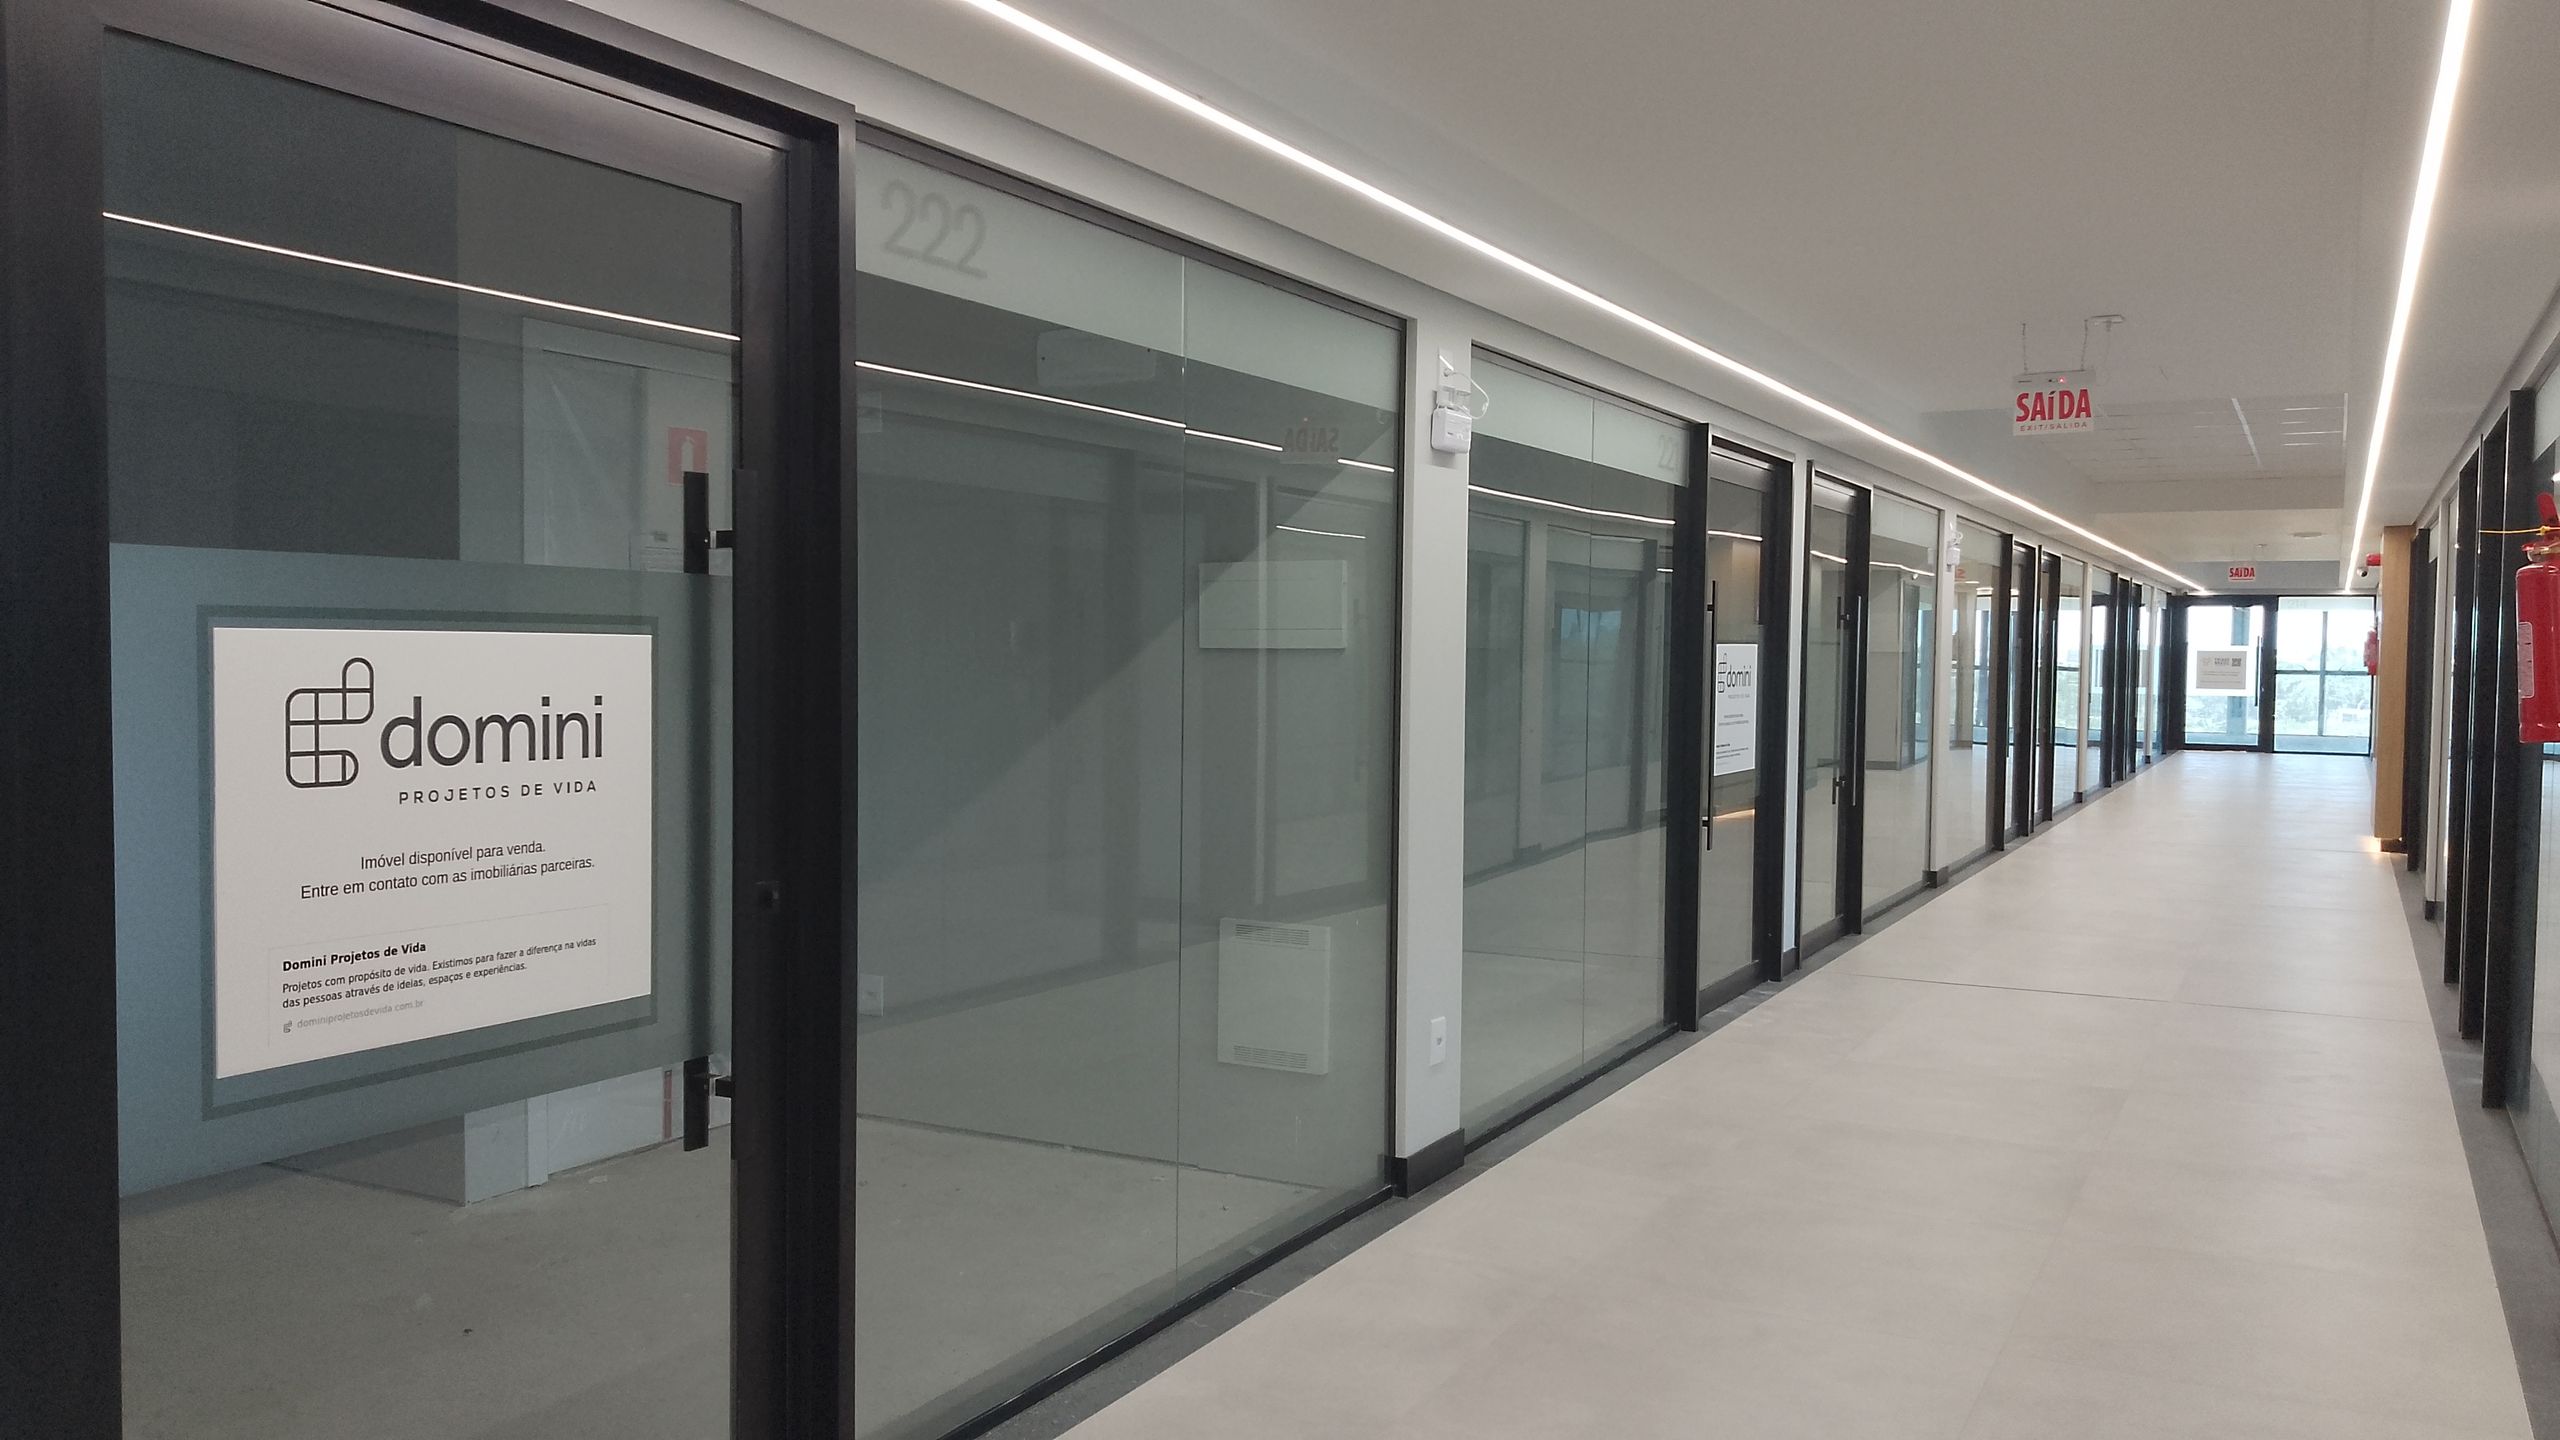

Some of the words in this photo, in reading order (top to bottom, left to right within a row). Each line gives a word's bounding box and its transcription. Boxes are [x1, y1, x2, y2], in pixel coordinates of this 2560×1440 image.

[881, 179, 987, 278] 222
[2016, 389, 2091, 422] SAÍDA
[2020, 422, 2087, 431] EXIT/SALIDA
[1726, 664, 1752, 688] domini
[380, 695, 603, 768] domini
[399, 785, 510, 805] PROJETOS
[520, 783, 544, 798] DE
[553, 780, 597, 795] VIDA
[361, 851, 405, 870] Imóvel
[408, 847, 473, 868] disponível
[476, 844, 504, 862] para
[506, 841, 546, 857] venda.
[300, 884, 339, 899] Entre
[343, 881, 365, 895] em
[368, 874, 418, 892] contato
[421, 873, 449, 886] com
[452, 870, 468, 883] as
[470, 861, 538, 881] imobiliárias
[540, 856, 595, 877] parceiras.
[282, 955, 327, 972] Domini
[330, 950, 380, 966] Projetos
[383, 946, 398, 957] de
[401, 942, 427, 954] Vida
[282, 980, 322, 994] Projetos
[324, 976, 346, 987] com
[348, 969, 392, 985] propósito
[394, 966, 406, 976] de
[432, 957, 474, 970] Existimos
[475, 954, 495, 965] para
[496, 948, 517, 960] fazer
[519, 949, 525, 957] a
[526, 943, 563, 956] diferença
[564, 942, 575, 950] na
[576, 938, 597, 948] vidas
[282, 997, 301, 1009] das
[303, 992, 343, 1007] pessoas
[345, 984, 380, 999] através
[383, 981, 395, 992] de
[428, 970, 464, 985] espaços
[465, 971, 472, 979] e
[473, 963, 528, 979] experiências.
